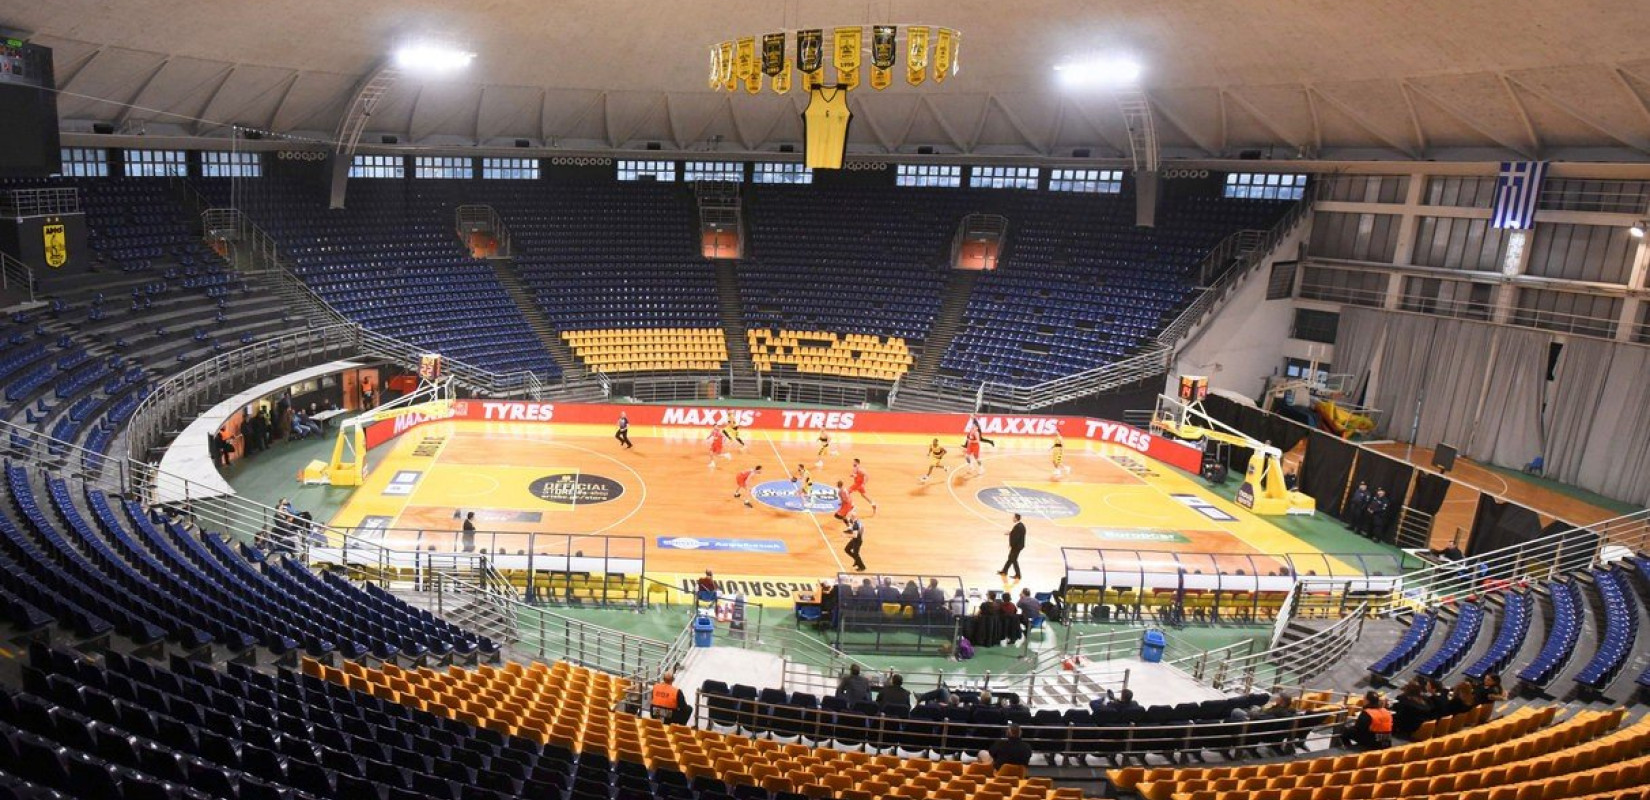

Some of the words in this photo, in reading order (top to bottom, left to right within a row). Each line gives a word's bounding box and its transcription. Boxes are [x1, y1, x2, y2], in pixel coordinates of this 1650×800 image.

[482, 403, 554, 421] TYRES
[661, 408, 755, 426] MAXXIS
[781, 410, 855, 430] TYRES
[1085, 419, 1151, 452] TYRES
